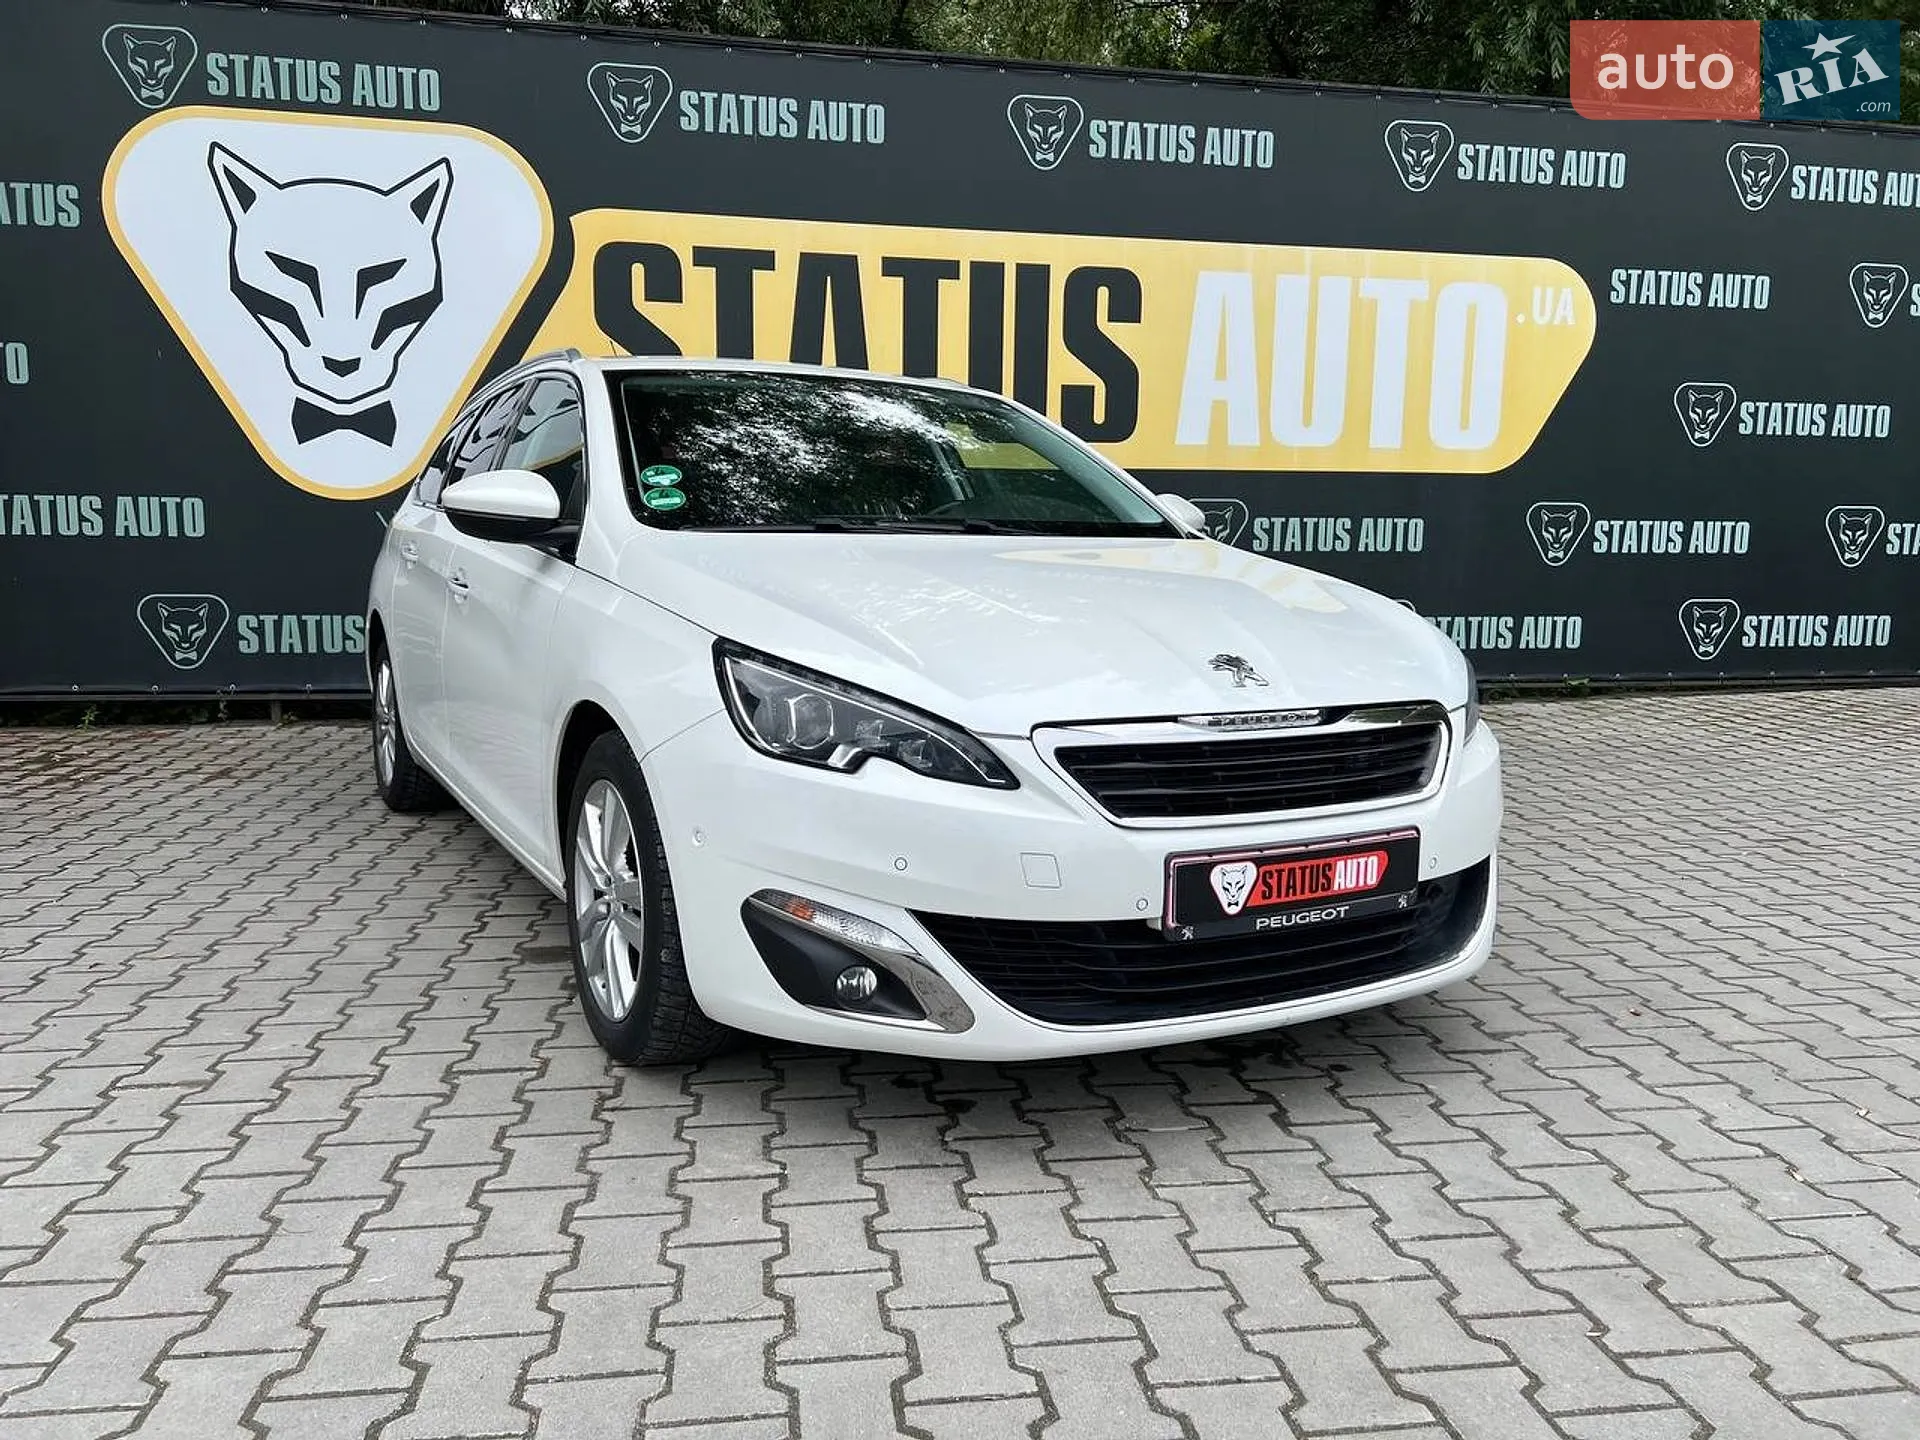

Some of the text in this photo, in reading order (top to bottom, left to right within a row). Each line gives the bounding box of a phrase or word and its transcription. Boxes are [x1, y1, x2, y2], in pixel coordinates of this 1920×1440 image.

[206, 52, 440, 111] STATUS AUTO
[679, 89, 885, 144] STATUS AUTO
[1088, 118, 1274, 169] STATUS AUTO
[1457, 143, 1626, 189] STATUS AUTO
[1790, 165, 1878, 204] STATUS
[1610, 268, 1769, 310] STATUS AUTO
[593, 241, 1142, 443] STATUS
[1175, 271, 1509, 450] AUTO
[1738, 400, 1890, 438] STATUS AUTO
[115, 495, 204, 537] AUTO
[1251, 516, 1424, 553] STATUS AUTO
[1592, 519, 1750, 554] STATUS AUTO
[238, 614, 365, 654] STATUS
[1424, 615, 1582, 650] TATUS AUTO
[1740, 614, 1891, 648] STATUS AUTO
[1256, 906, 1350, 930] PEUGEOT
